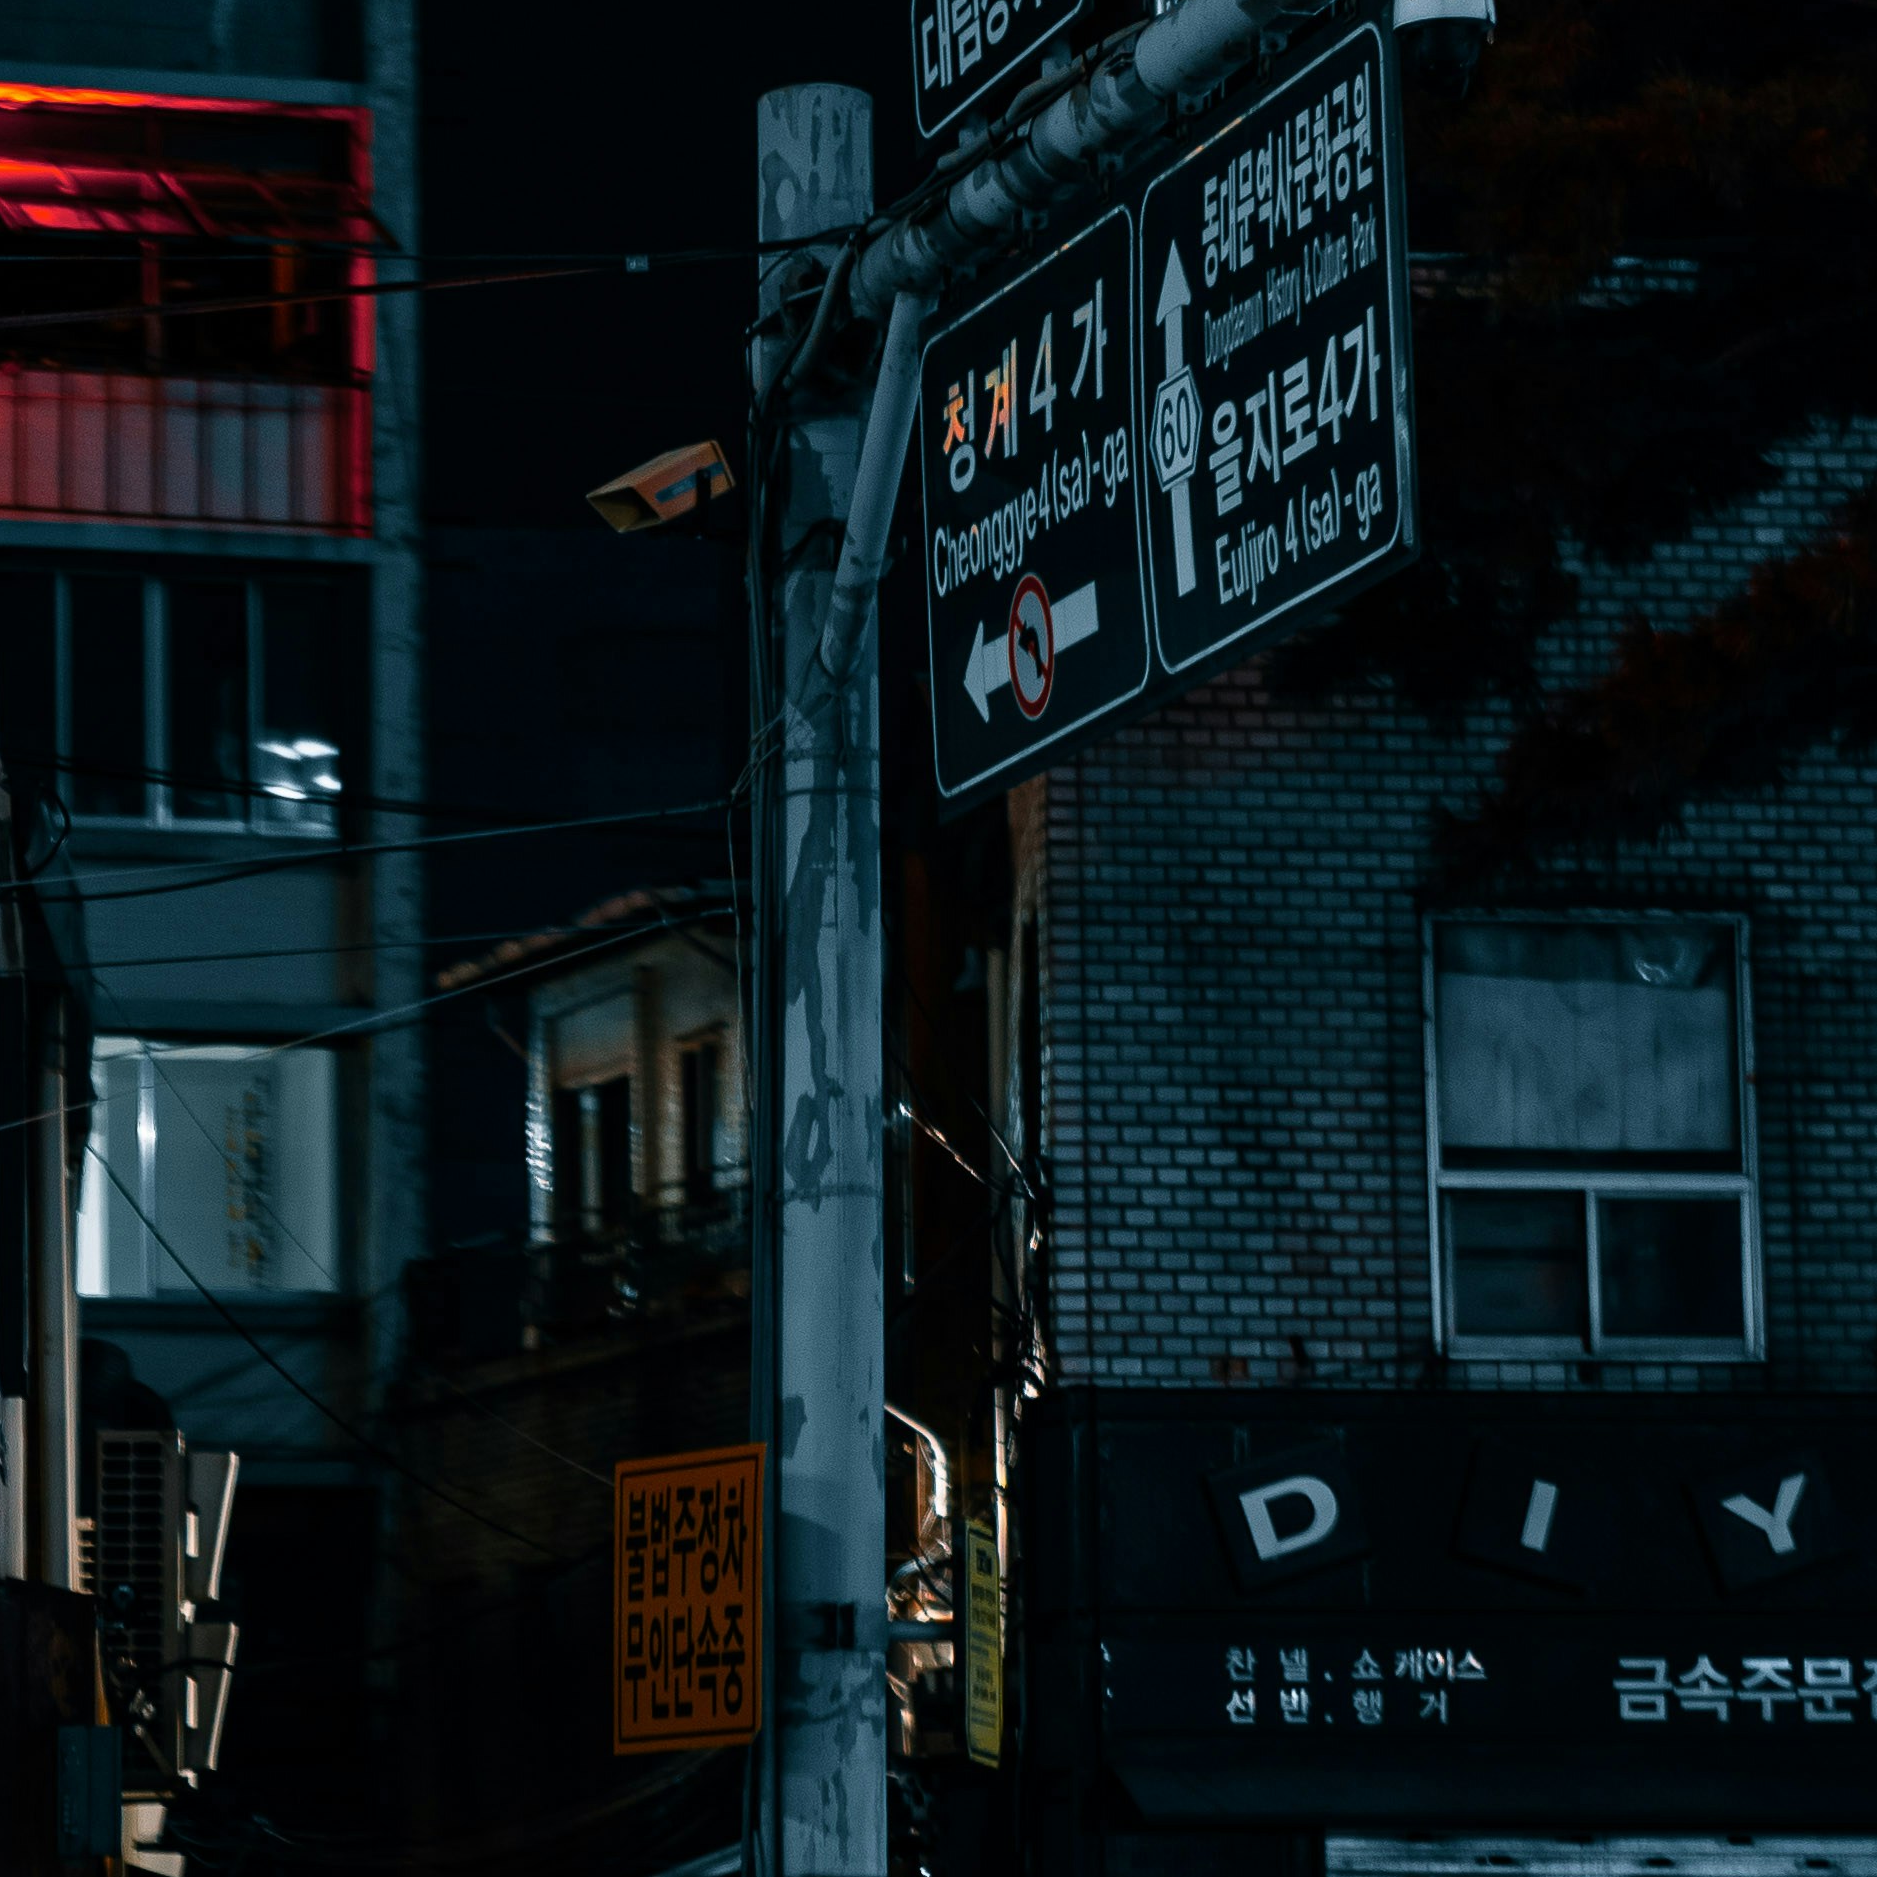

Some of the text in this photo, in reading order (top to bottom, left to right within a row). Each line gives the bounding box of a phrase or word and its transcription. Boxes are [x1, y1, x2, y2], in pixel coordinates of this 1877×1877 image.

[1201, 61, 1374, 289] 동대문역사문화공원
[1352, 202, 1377, 273] Park
[1160, 386, 1191, 468] 60
[1208, 305, 1381, 517] 을지로4가
[625, 1477, 748, 1603] 불법주정차
[624, 1604, 746, 1724] 무인단속중
[1611, 1653, 1877, 1724] 금속주문
